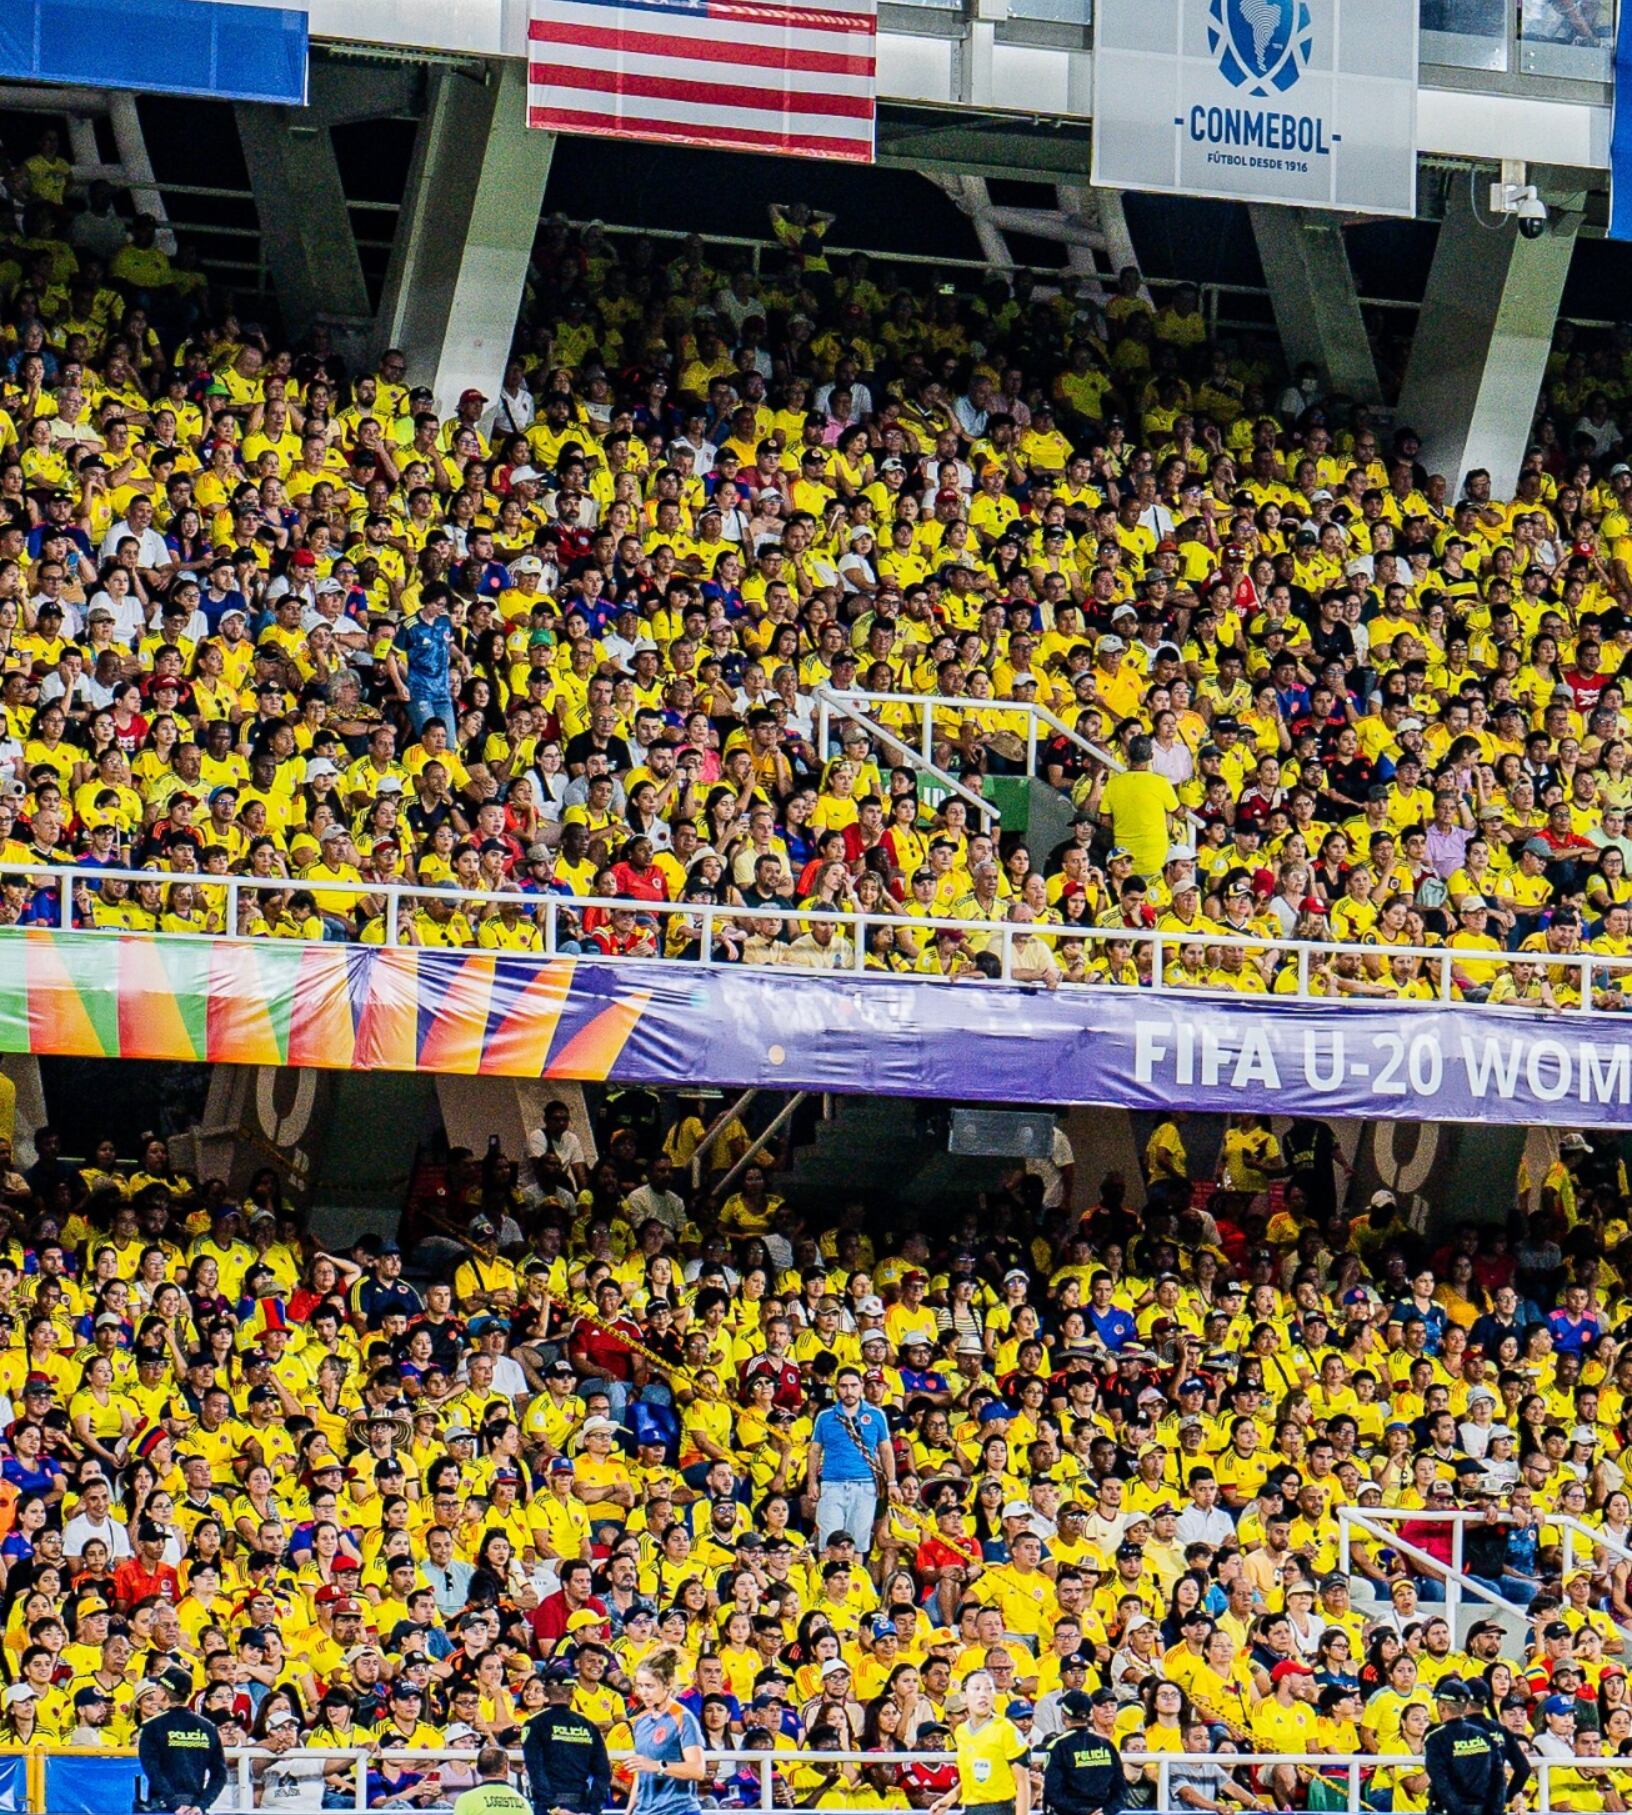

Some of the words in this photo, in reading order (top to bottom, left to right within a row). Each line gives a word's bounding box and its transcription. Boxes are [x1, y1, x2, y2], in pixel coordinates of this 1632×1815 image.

[1207, 152, 1247, 166] FÚTBOL
[1249, 157, 1283, 170] DESDE
[1284, 161, 1308, 173] 1916
[1135, 1020, 1281, 1090] FIFA
[1303, 1029, 1443, 1097] U-20
[168, 1728, 209, 1742] POLICÍA
[552, 1725, 590, 1737] POLICÍA
[1073, 1747, 1111, 1762] POLICÍA
